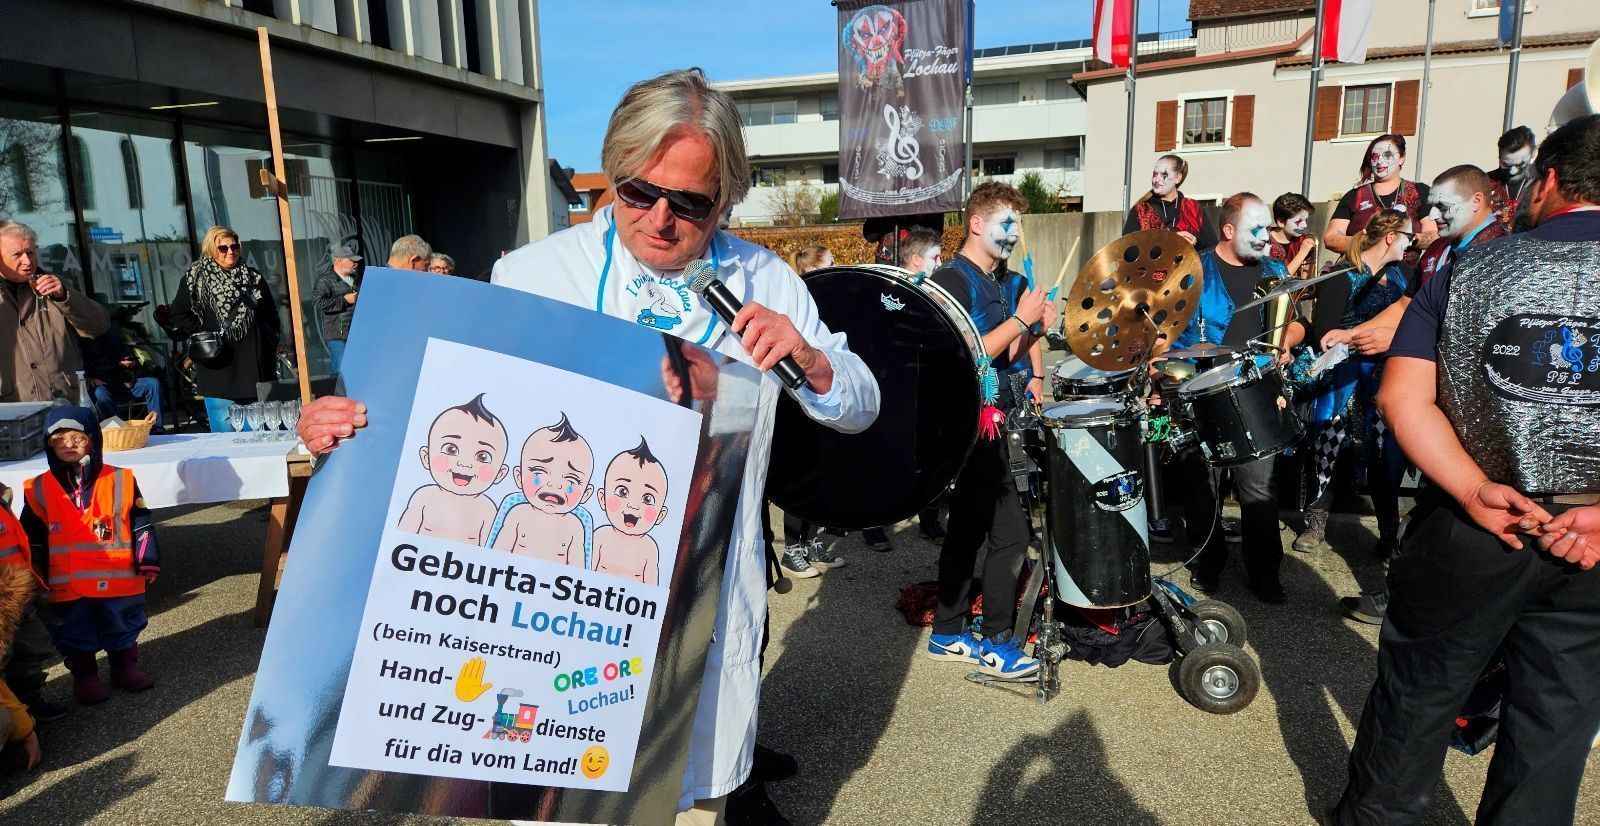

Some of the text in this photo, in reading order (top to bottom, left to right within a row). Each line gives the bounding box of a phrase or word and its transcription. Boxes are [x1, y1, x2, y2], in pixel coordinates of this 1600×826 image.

[903, 57, 958, 78] Lochau
[38, 247, 278, 272] EAMT LOAU
[626, 284, 638, 297] I
[659, 273, 691, 312] Lochauer
[1492, 344, 1521, 356] 2022
[391, 543, 657, 620] Geburta-Station
[410, 588, 633, 648] noch Lochau!
[373, 622, 561, 668] (beim Kaiserstrand)
[379, 659, 453, 686] Hand-
[553, 657, 643, 692] ORE ORE
[567, 684, 635, 715] Lochau!
[378, 702, 606, 743] und Zug- dienste
[384, 738, 578, 775] für dia vom Land!
